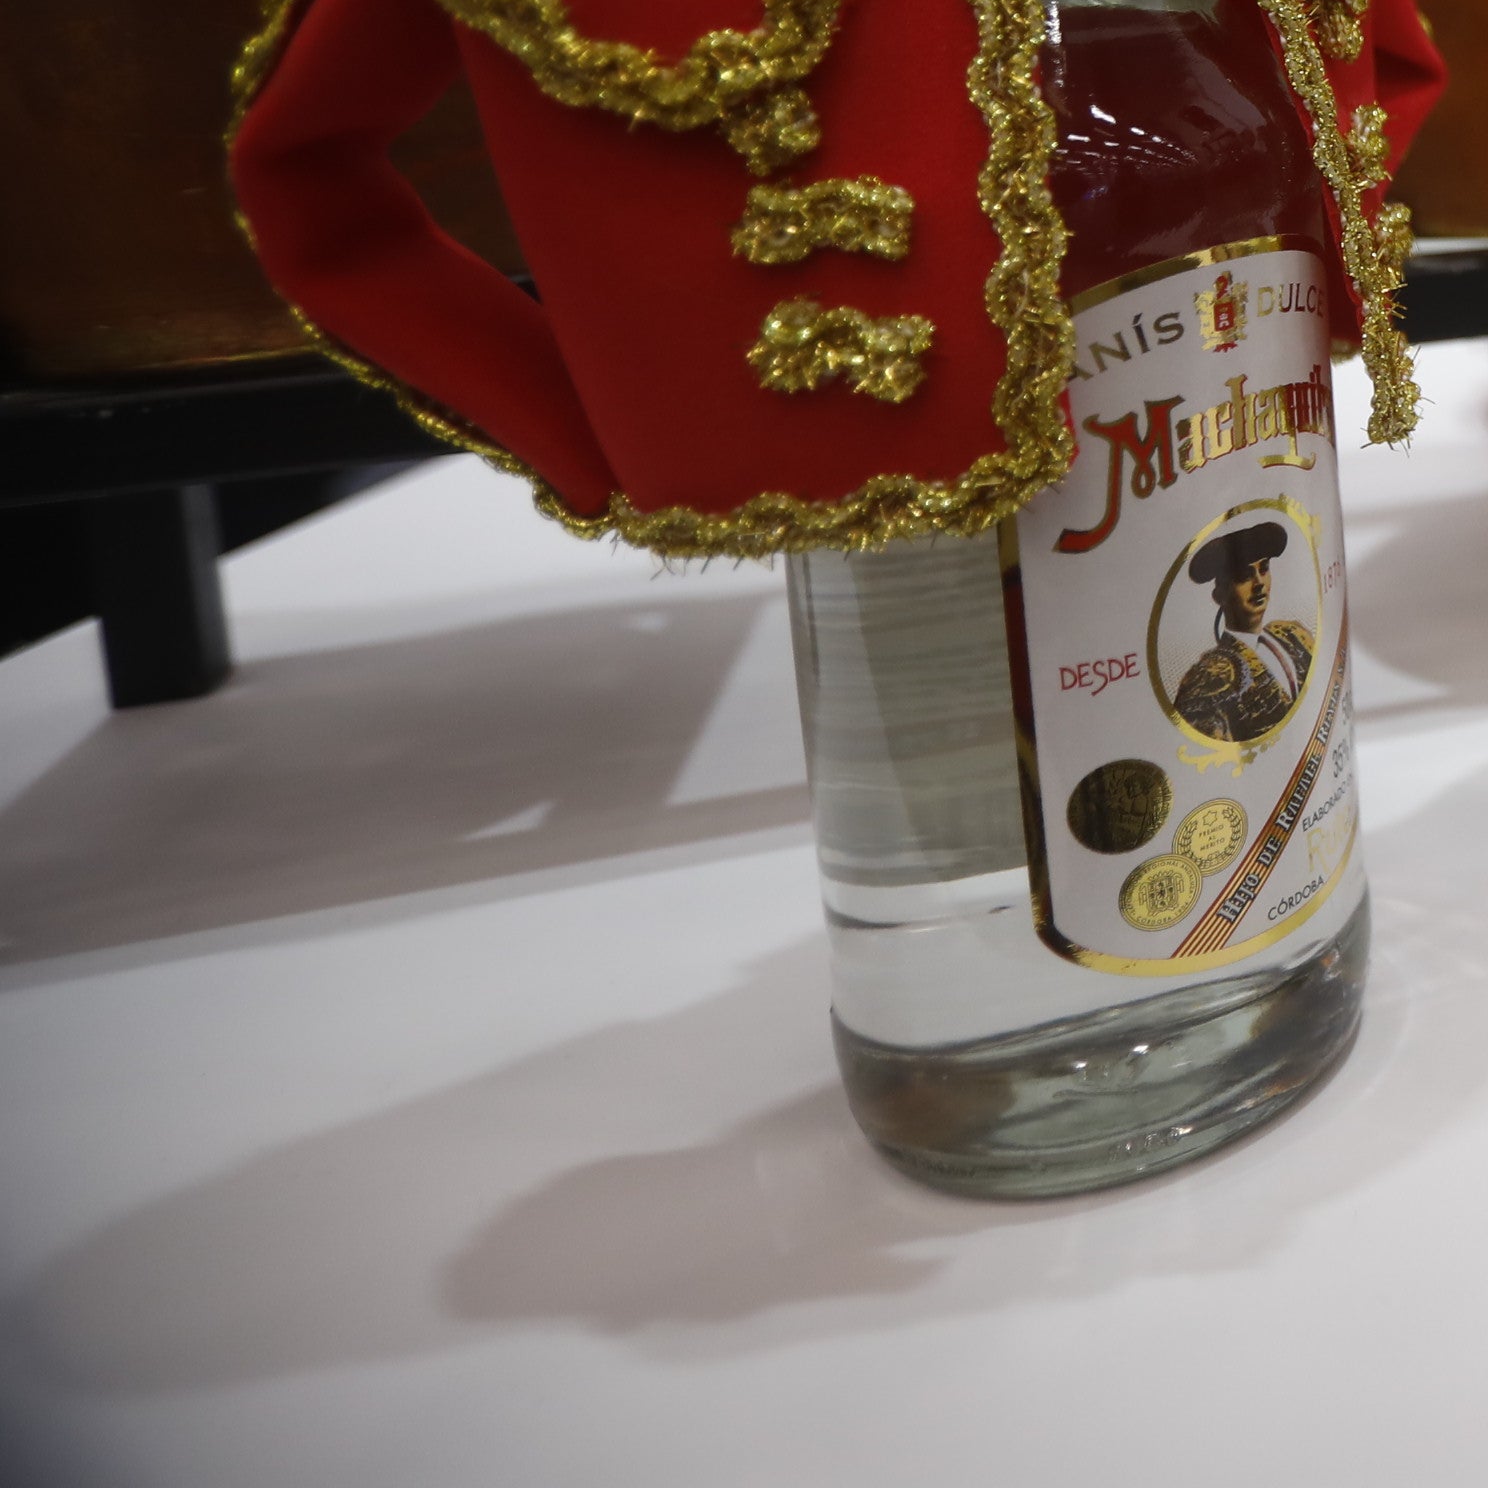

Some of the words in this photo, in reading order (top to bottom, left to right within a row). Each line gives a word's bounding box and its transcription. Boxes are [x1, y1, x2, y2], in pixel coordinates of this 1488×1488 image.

[1052, 363, 1337, 554] Machaquit
[1059, 653, 1141, 696] DESDE
[1217, 872, 1260, 923] HIJO
[1258, 835, 1282, 869] DE
[1276, 753, 1322, 832] RAFAEL
[1267, 875, 1325, 921] CÓRDOBA
